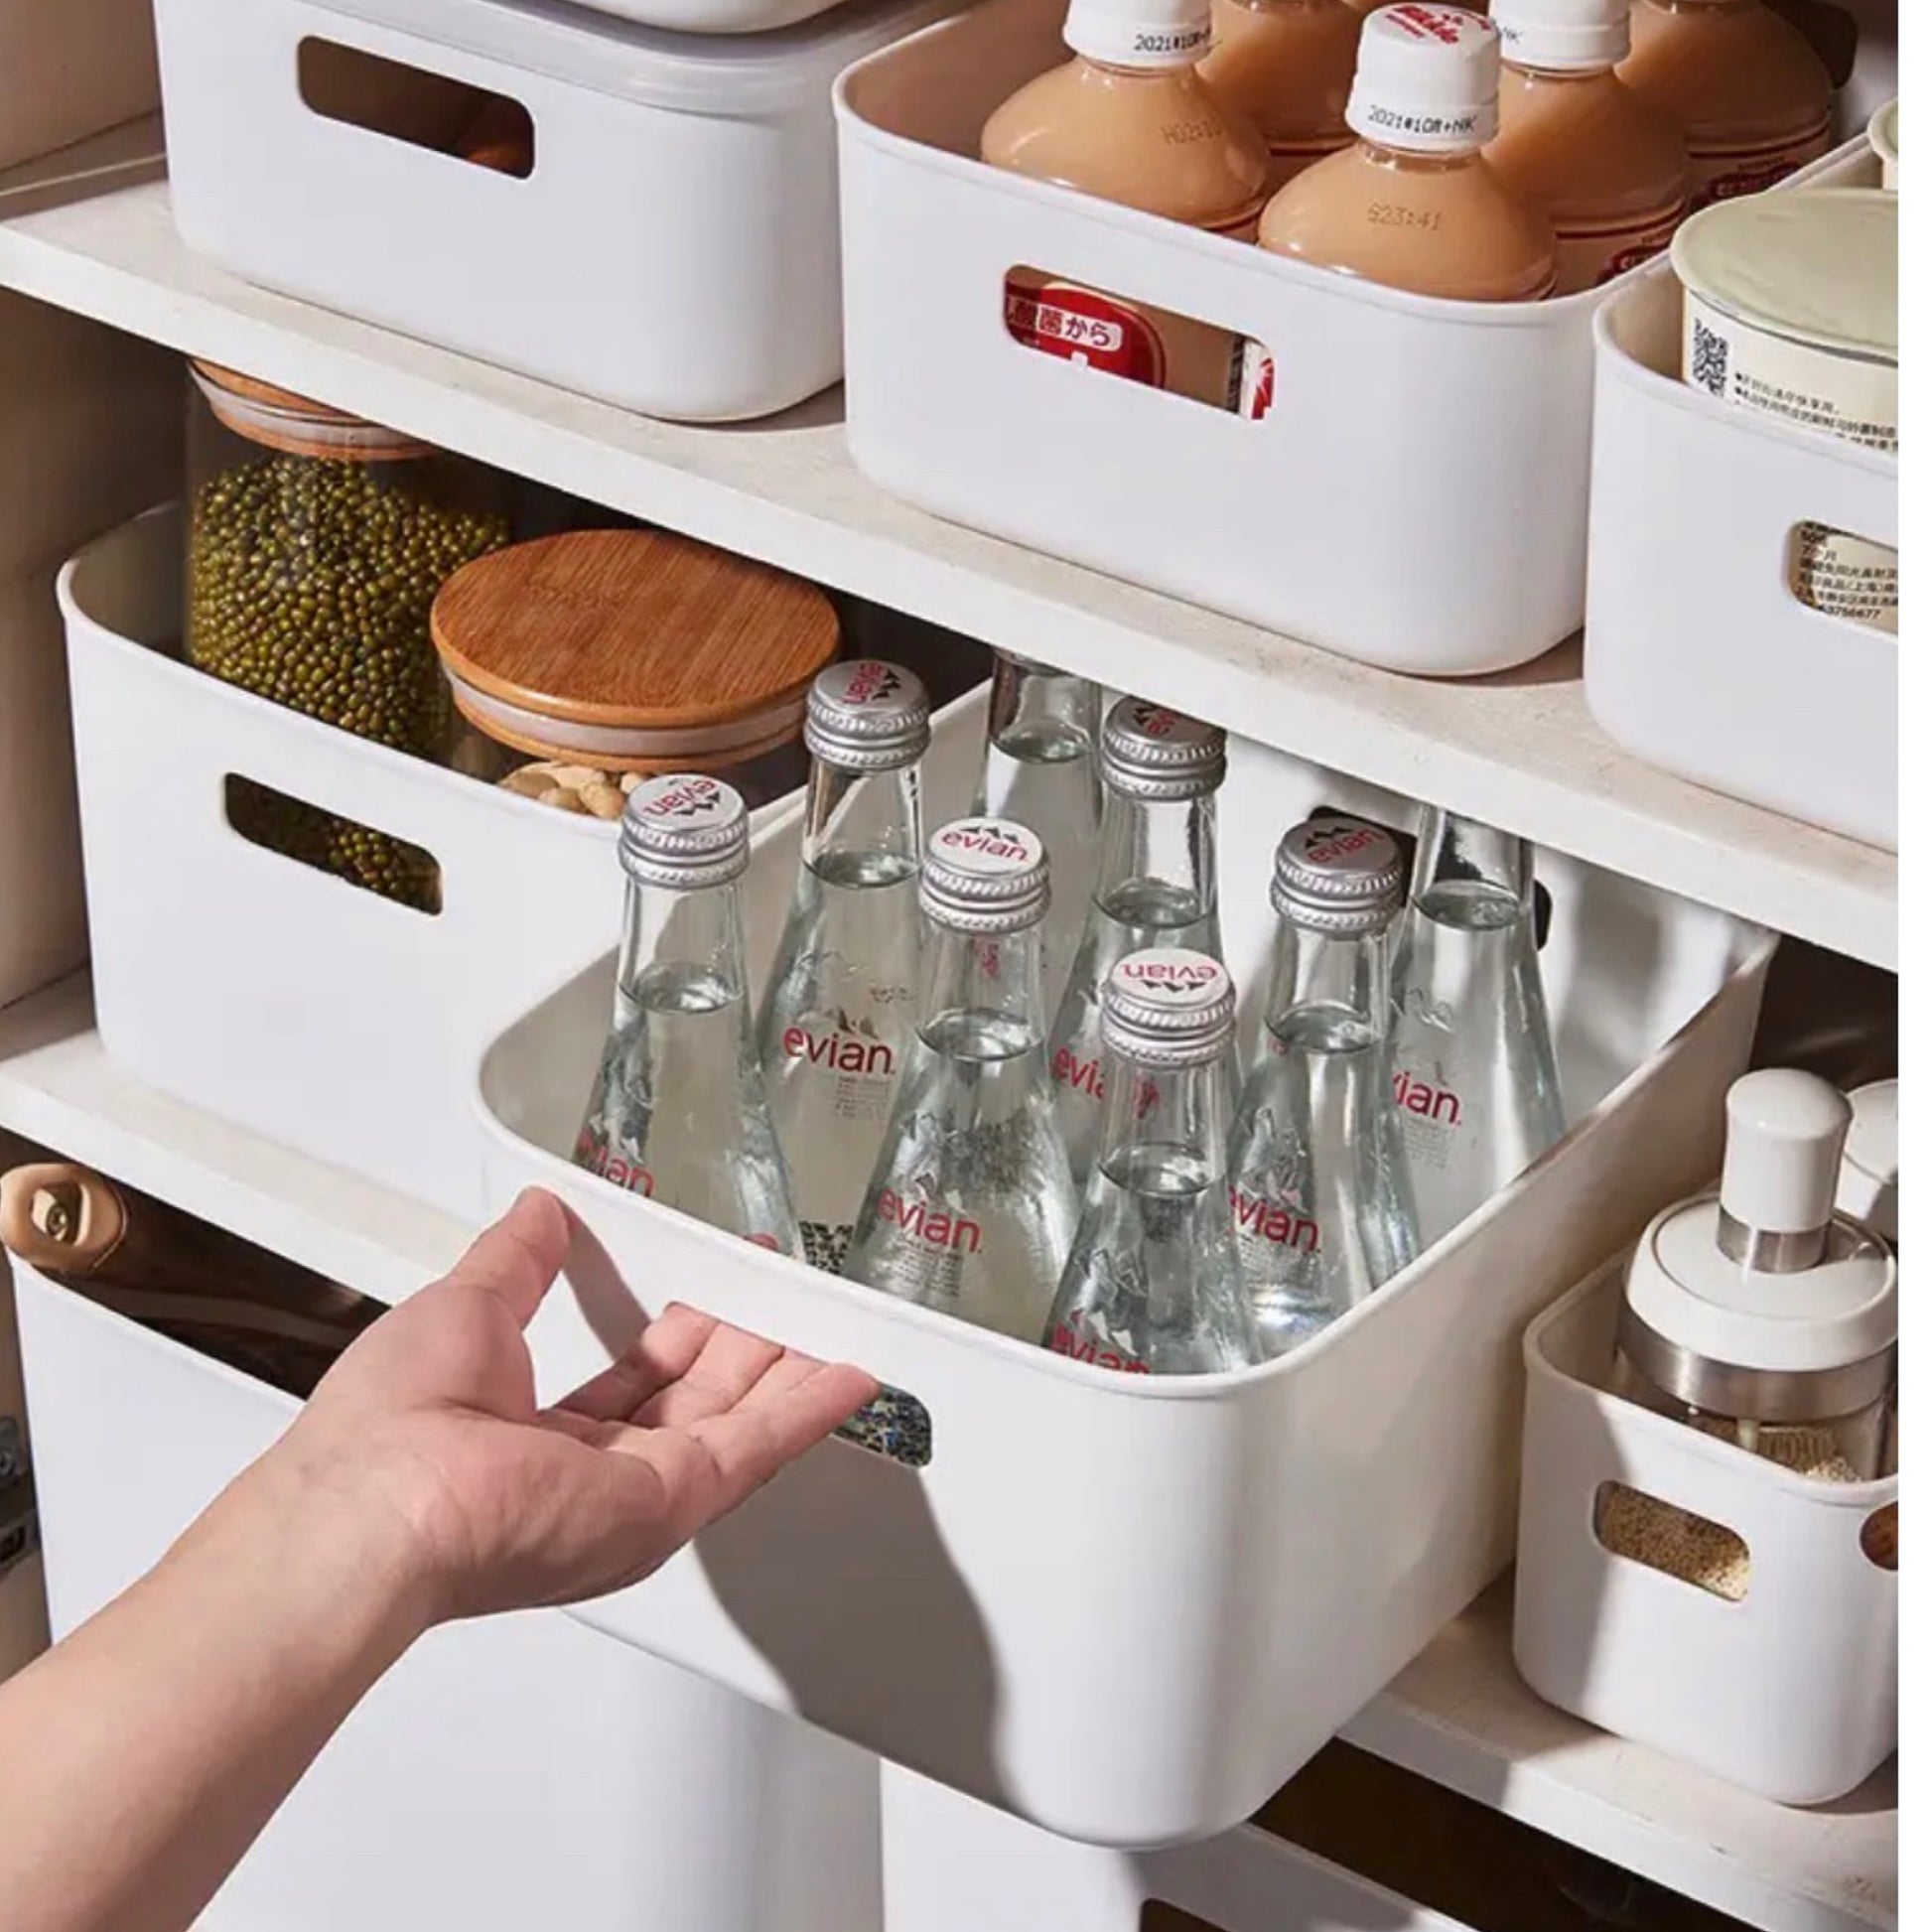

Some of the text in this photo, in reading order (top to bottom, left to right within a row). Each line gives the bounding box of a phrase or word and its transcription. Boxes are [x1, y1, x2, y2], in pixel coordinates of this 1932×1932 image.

[842, 662, 885, 704] evian
[643, 777, 717, 817] evian
[941, 831, 1029, 862] evian
[1307, 828, 1386, 864] evian
[1123, 963, 1218, 981] evian
